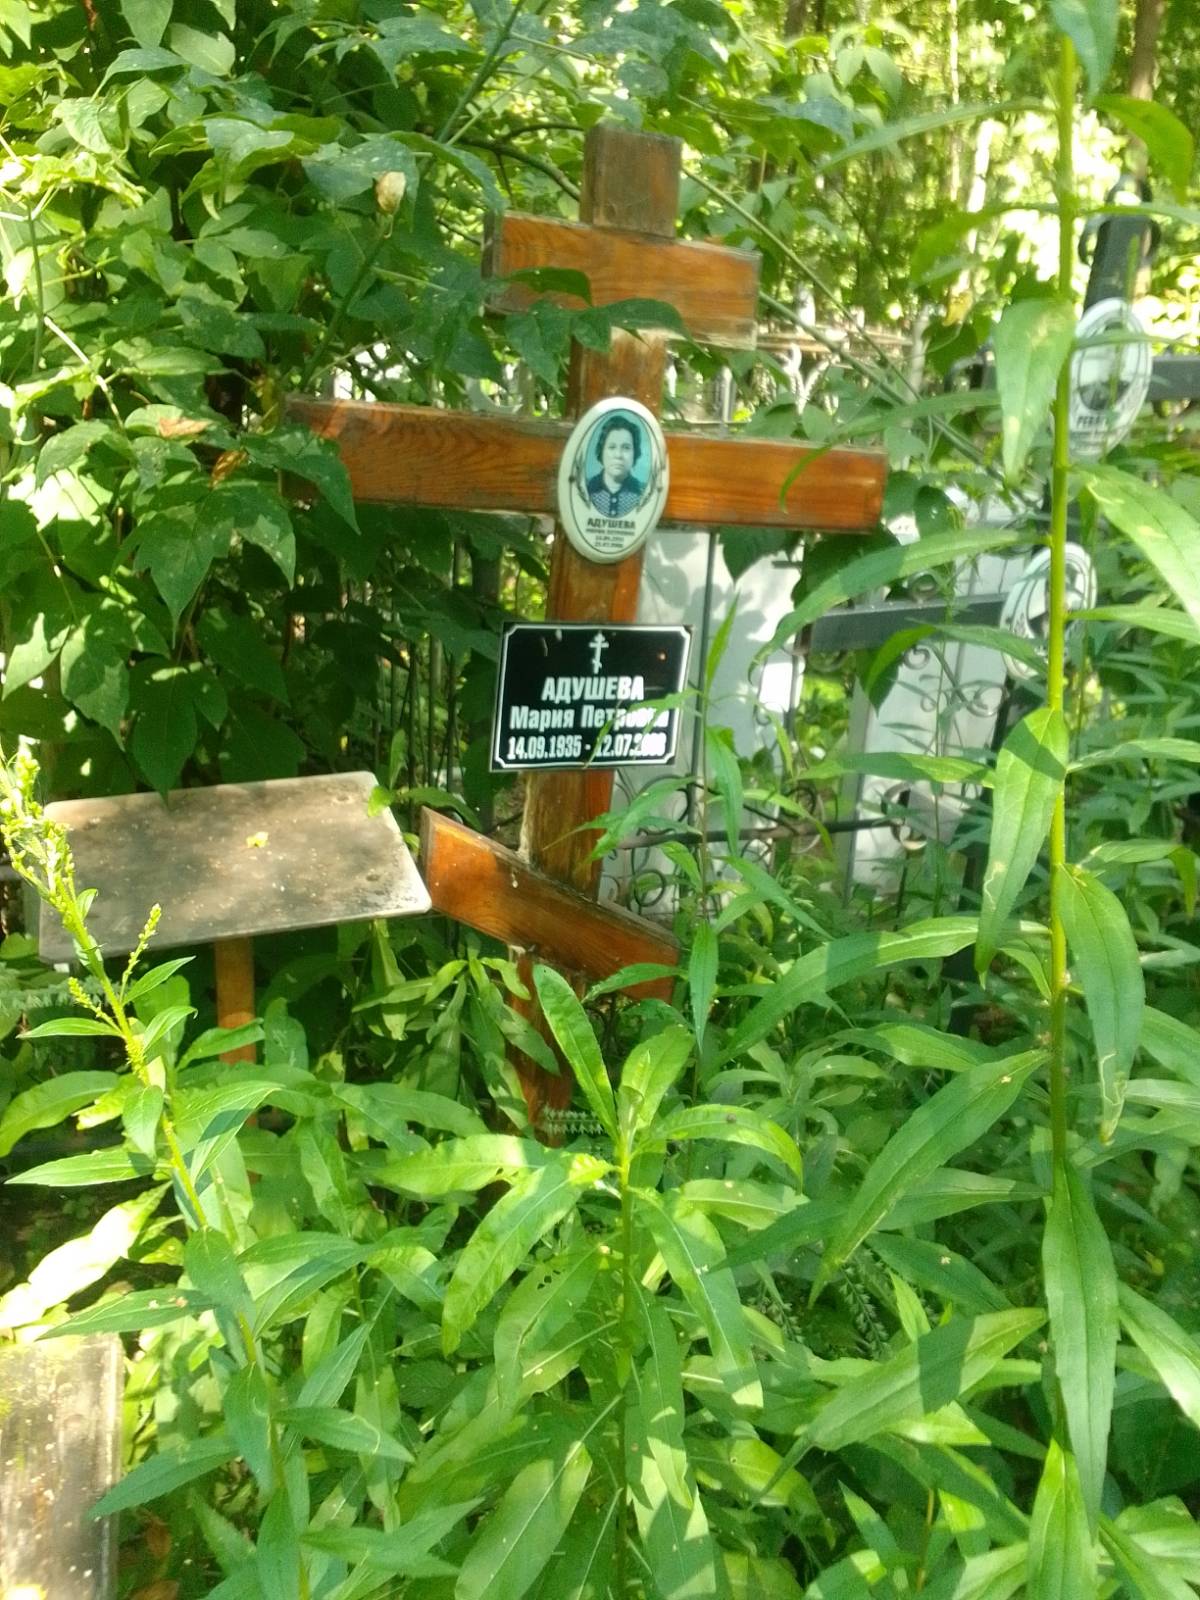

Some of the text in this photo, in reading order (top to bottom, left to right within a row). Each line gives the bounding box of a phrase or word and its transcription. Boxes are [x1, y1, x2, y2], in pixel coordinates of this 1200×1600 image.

[587, 517, 636, 530] АДУШЕВА
[541, 676, 645, 704] АДУШЕВА
[509, 706, 575, 732] Мария
[507, 735, 582, 760] 14.09.1935
